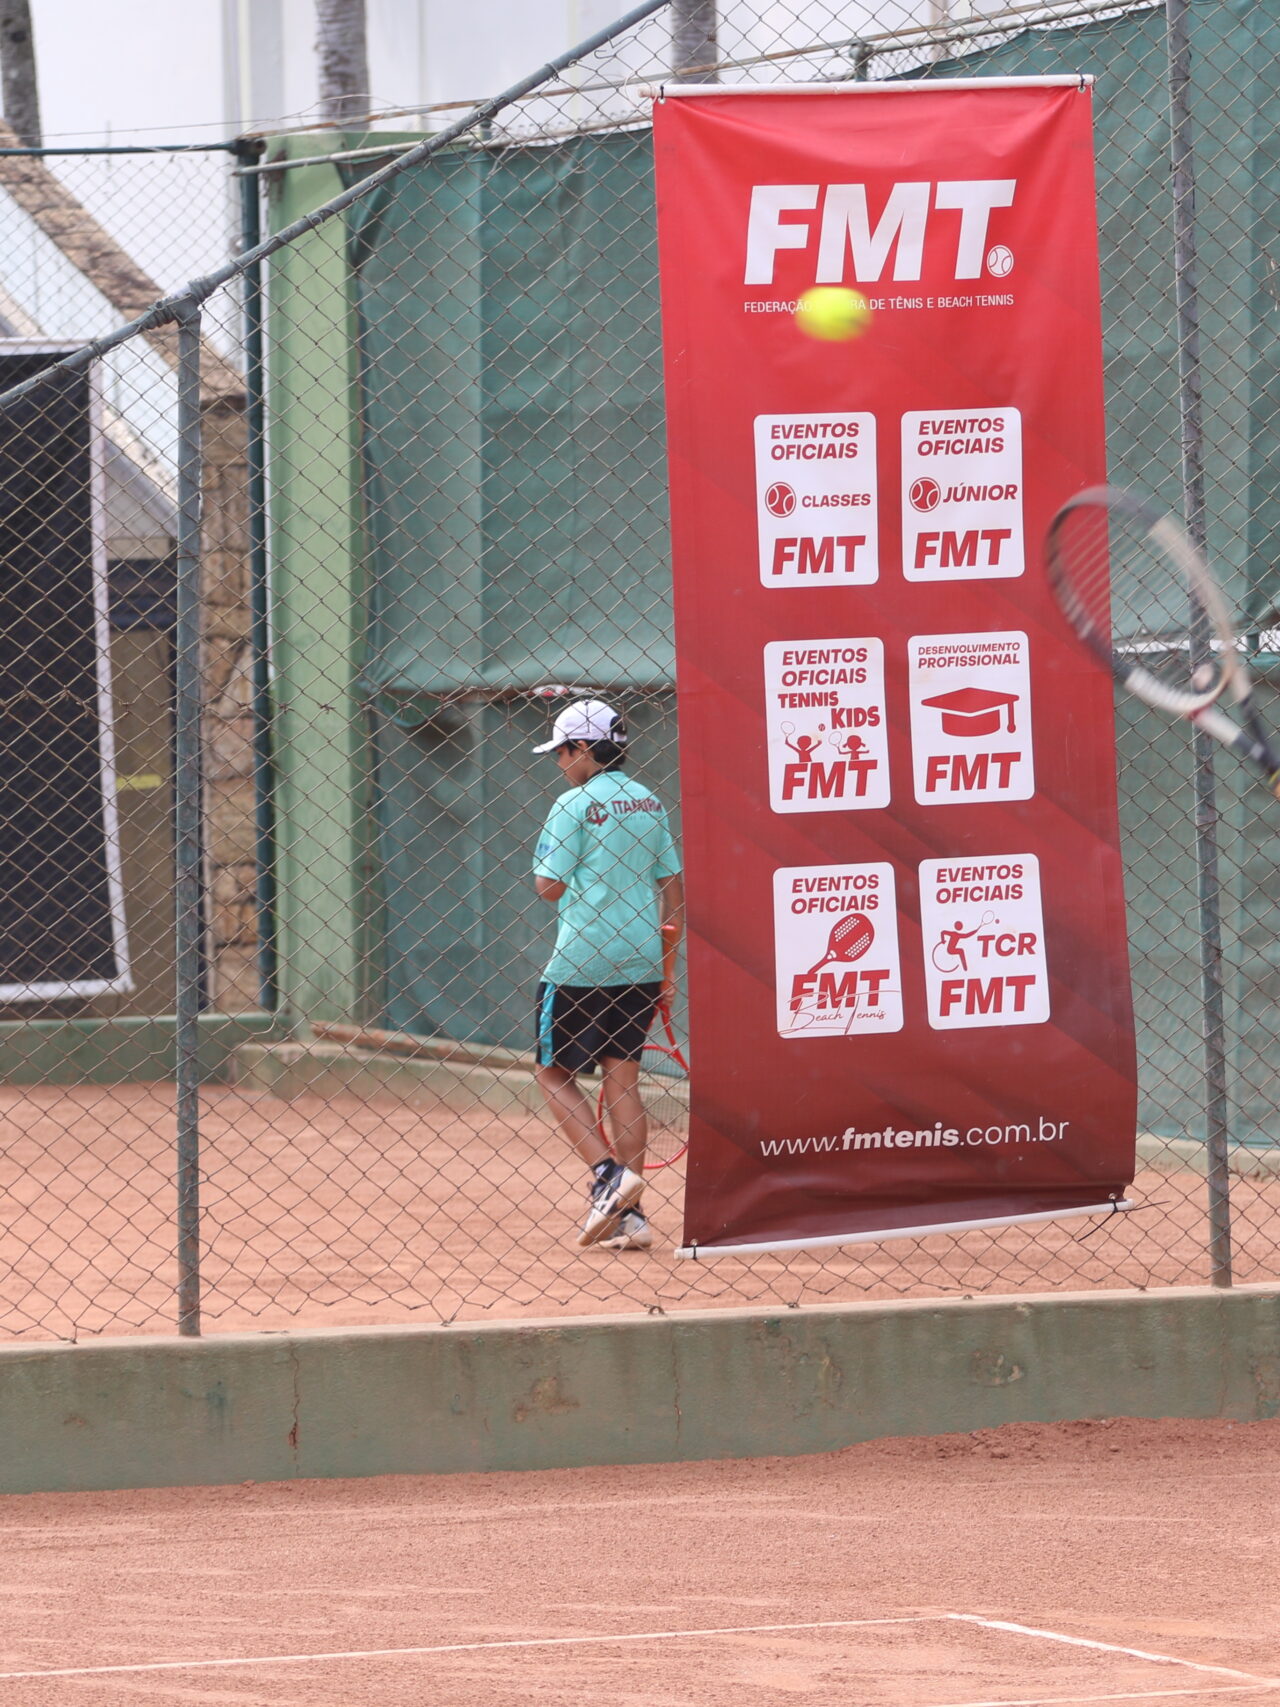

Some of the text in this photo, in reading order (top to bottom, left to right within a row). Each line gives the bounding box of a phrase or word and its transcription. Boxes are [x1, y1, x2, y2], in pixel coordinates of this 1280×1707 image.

[744, 179, 1017, 285] FMT
[869, 299, 886, 310] DE
[889, 296, 923, 310] TÊNIS
[926, 298, 934, 309] E
[937, 296, 973, 308] BEACH
[975, 294, 1014, 307] TENNIS
[771, 422, 859, 439] EVENTOS
[918, 418, 1005, 435] EVENTOS
[771, 443, 858, 461] OFICIAIS
[917, 437, 1004, 456] OFICIAIS
[801, 494, 871, 508] CLASSES
[943, 483, 1018, 503] JÚNIOR
[772, 535, 866, 575] FMT
[914, 528, 1012, 569] FMT
[782, 648, 868, 666] EVENTOS
[918, 642, 1021, 655] DESENVOLVIMENTO
[918, 654, 1020, 669] PROFISSIONAL
[781, 668, 867, 686] OFICIAIS
[778, 691, 839, 708] TENNIS
[831, 706, 880, 730] KIDS
[781, 759, 878, 800] FMT
[925, 752, 1021, 792] FMT
[791, 874, 879, 893] EVENTOS
[936, 864, 1023, 883] EVENTOS
[936, 884, 1023, 904] OFICIAIS
[791, 894, 879, 915] OFICIAIS
[977, 932, 1037, 958] TCR
[790, 969, 890, 1011] FMT
[939, 975, 1036, 1017] FMT
[785, 991, 843, 1035] Beach
[760, 1116, 1069, 1157] www.fmtenis.com.br
